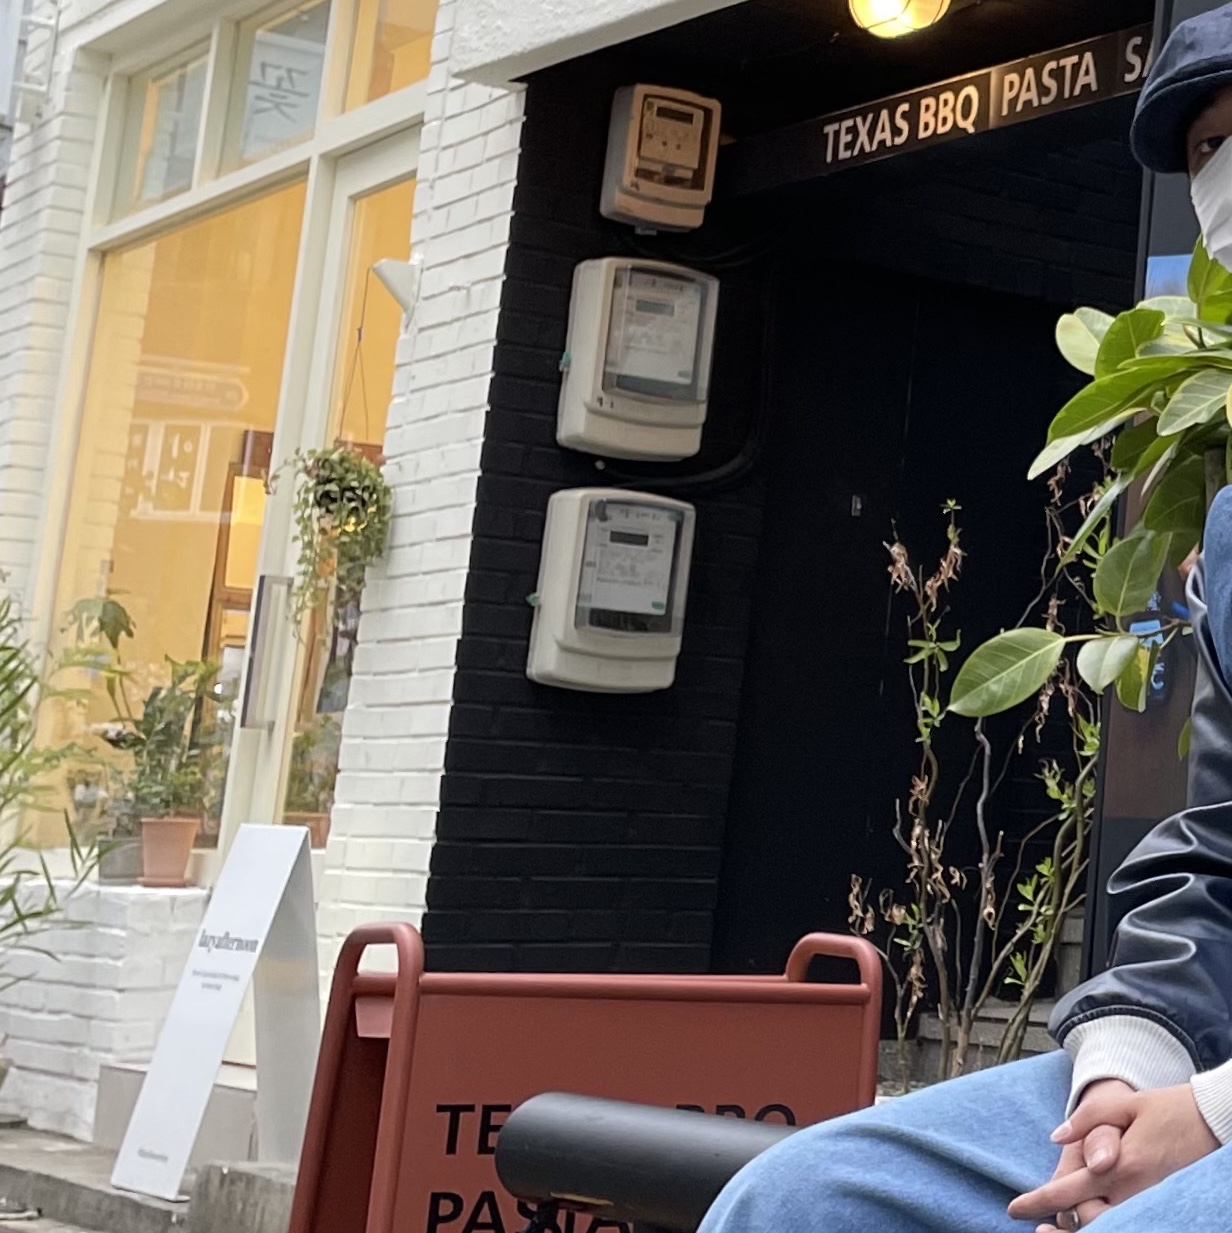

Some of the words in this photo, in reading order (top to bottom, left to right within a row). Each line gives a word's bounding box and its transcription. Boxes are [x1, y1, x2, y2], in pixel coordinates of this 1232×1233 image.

[823, 104, 910, 163] TEXAS
[917, 85, 980, 140] BBQ
[1001, 52, 1099, 116] PASTA
